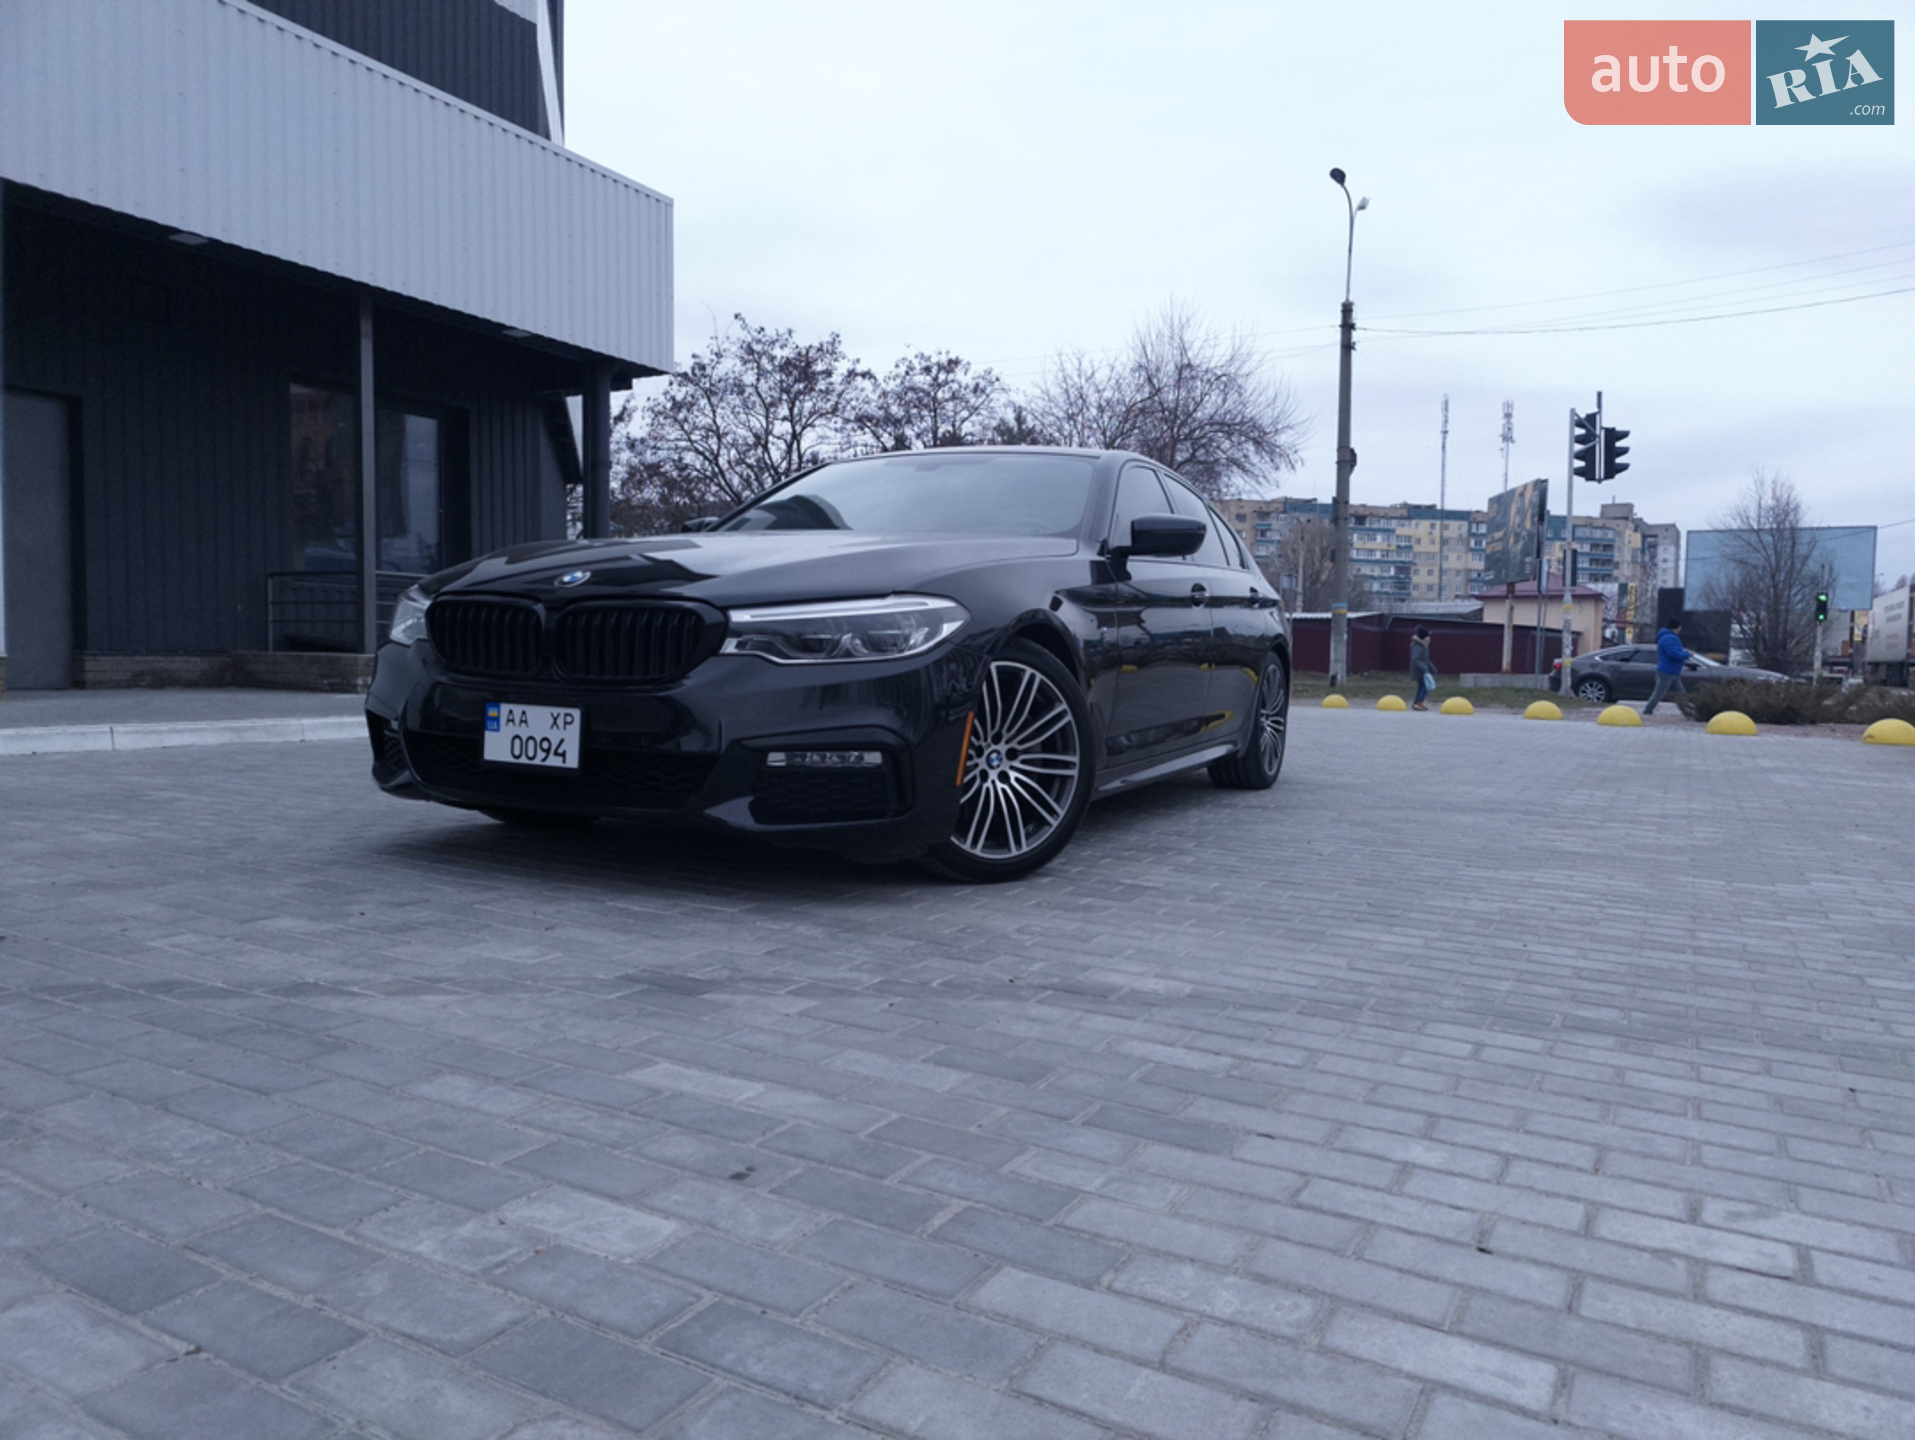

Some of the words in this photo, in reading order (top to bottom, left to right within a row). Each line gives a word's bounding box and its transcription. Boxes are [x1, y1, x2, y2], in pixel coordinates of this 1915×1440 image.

[505, 709, 529, 728] AA
[549, 711, 575, 731] XP
[510, 734, 567, 764] 0094
